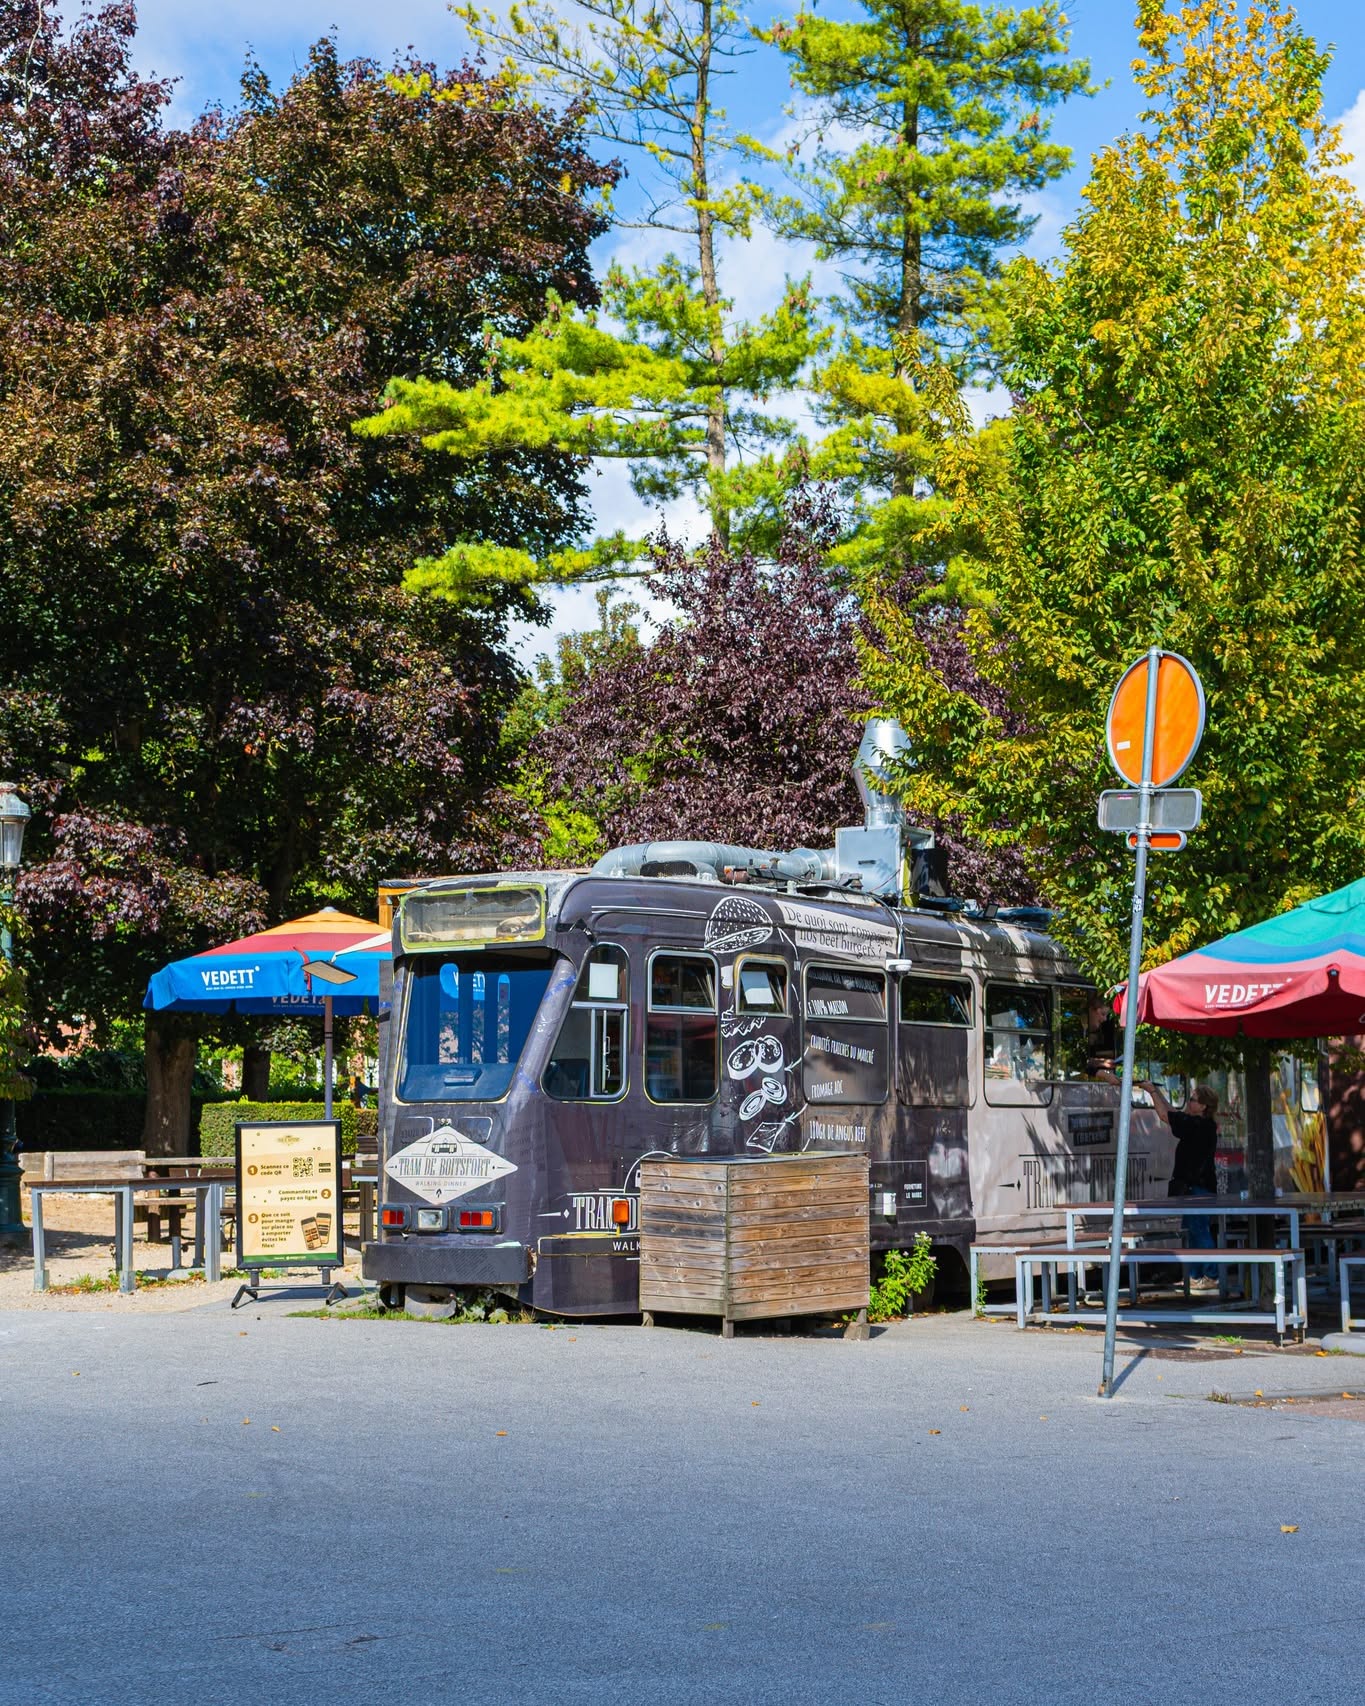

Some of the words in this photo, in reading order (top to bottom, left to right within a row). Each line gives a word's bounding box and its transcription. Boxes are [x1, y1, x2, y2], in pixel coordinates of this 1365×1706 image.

[784, 906, 802, 923] De
[805, 914, 825, 930] quoi
[828, 919, 848, 933] sont
[841, 934, 876, 958] burgers
[201, 968, 255, 986] VEDETT
[811, 1081, 833, 1098] FROMAGE
[827, 1124, 835, 1140] DE
[835, 1124, 854, 1142] ANGUS
[855, 1126, 866, 1142] BEEF
[399, 1158, 420, 1176] TRAM
[424, 1158, 437, 1176] DE
[440, 1157, 491, 1177] BOITSFORT
